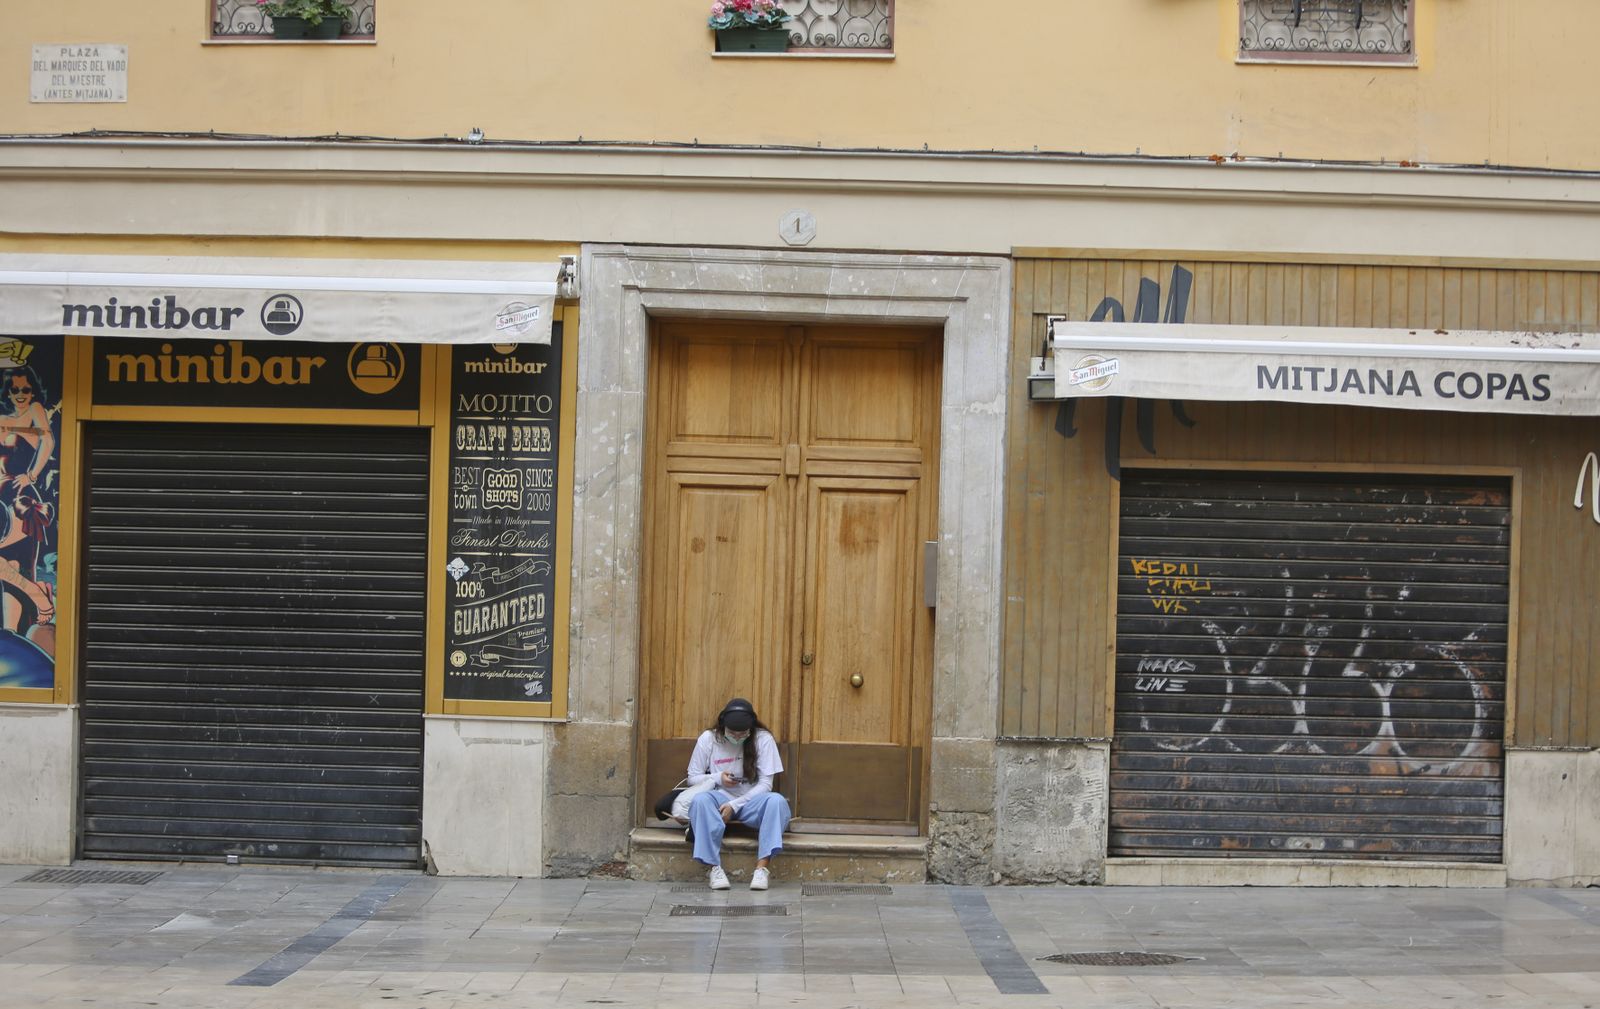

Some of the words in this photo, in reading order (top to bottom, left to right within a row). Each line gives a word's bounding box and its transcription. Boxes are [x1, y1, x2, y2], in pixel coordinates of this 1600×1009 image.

[60, 48, 99, 57] PLAZA
[33, 61, 48, 71] DEL
[51, 61, 87, 72] MARQUES
[90, 61, 104, 71] DEL
[107, 61, 126, 72] VADO
[52, 75, 66, 86] DEL
[70, 75, 106, 86] MAESTRE
[44, 89, 73, 99] (ANTES
[76, 89, 113, 100] MITJANA)
[792, 217, 801, 233] 1
[62, 296, 244, 331] minibar
[106, 341, 327, 385] minibar
[464, 357, 548, 375] minibar
[1257, 365, 1422, 398] MITJANA
[1434, 371, 1551, 402] COPAS
[457, 394, 553, 413] MOJITO
[456, 425, 507, 451] CRAFT
[511, 426, 552, 452] BEER
[454, 467, 480, 485] BEST
[487, 474, 518, 488] GOOD
[525, 468, 553, 488] SINCE
[454, 490, 478, 509] town
[486, 490, 519, 503] SHOTS
[526, 492, 551, 511] 2009
[451, 528, 500, 547] Finest
[498, 529, 551, 549] Drinks
[455, 581, 485, 598] 100%
[454, 592, 546, 636] GUARANTEED
